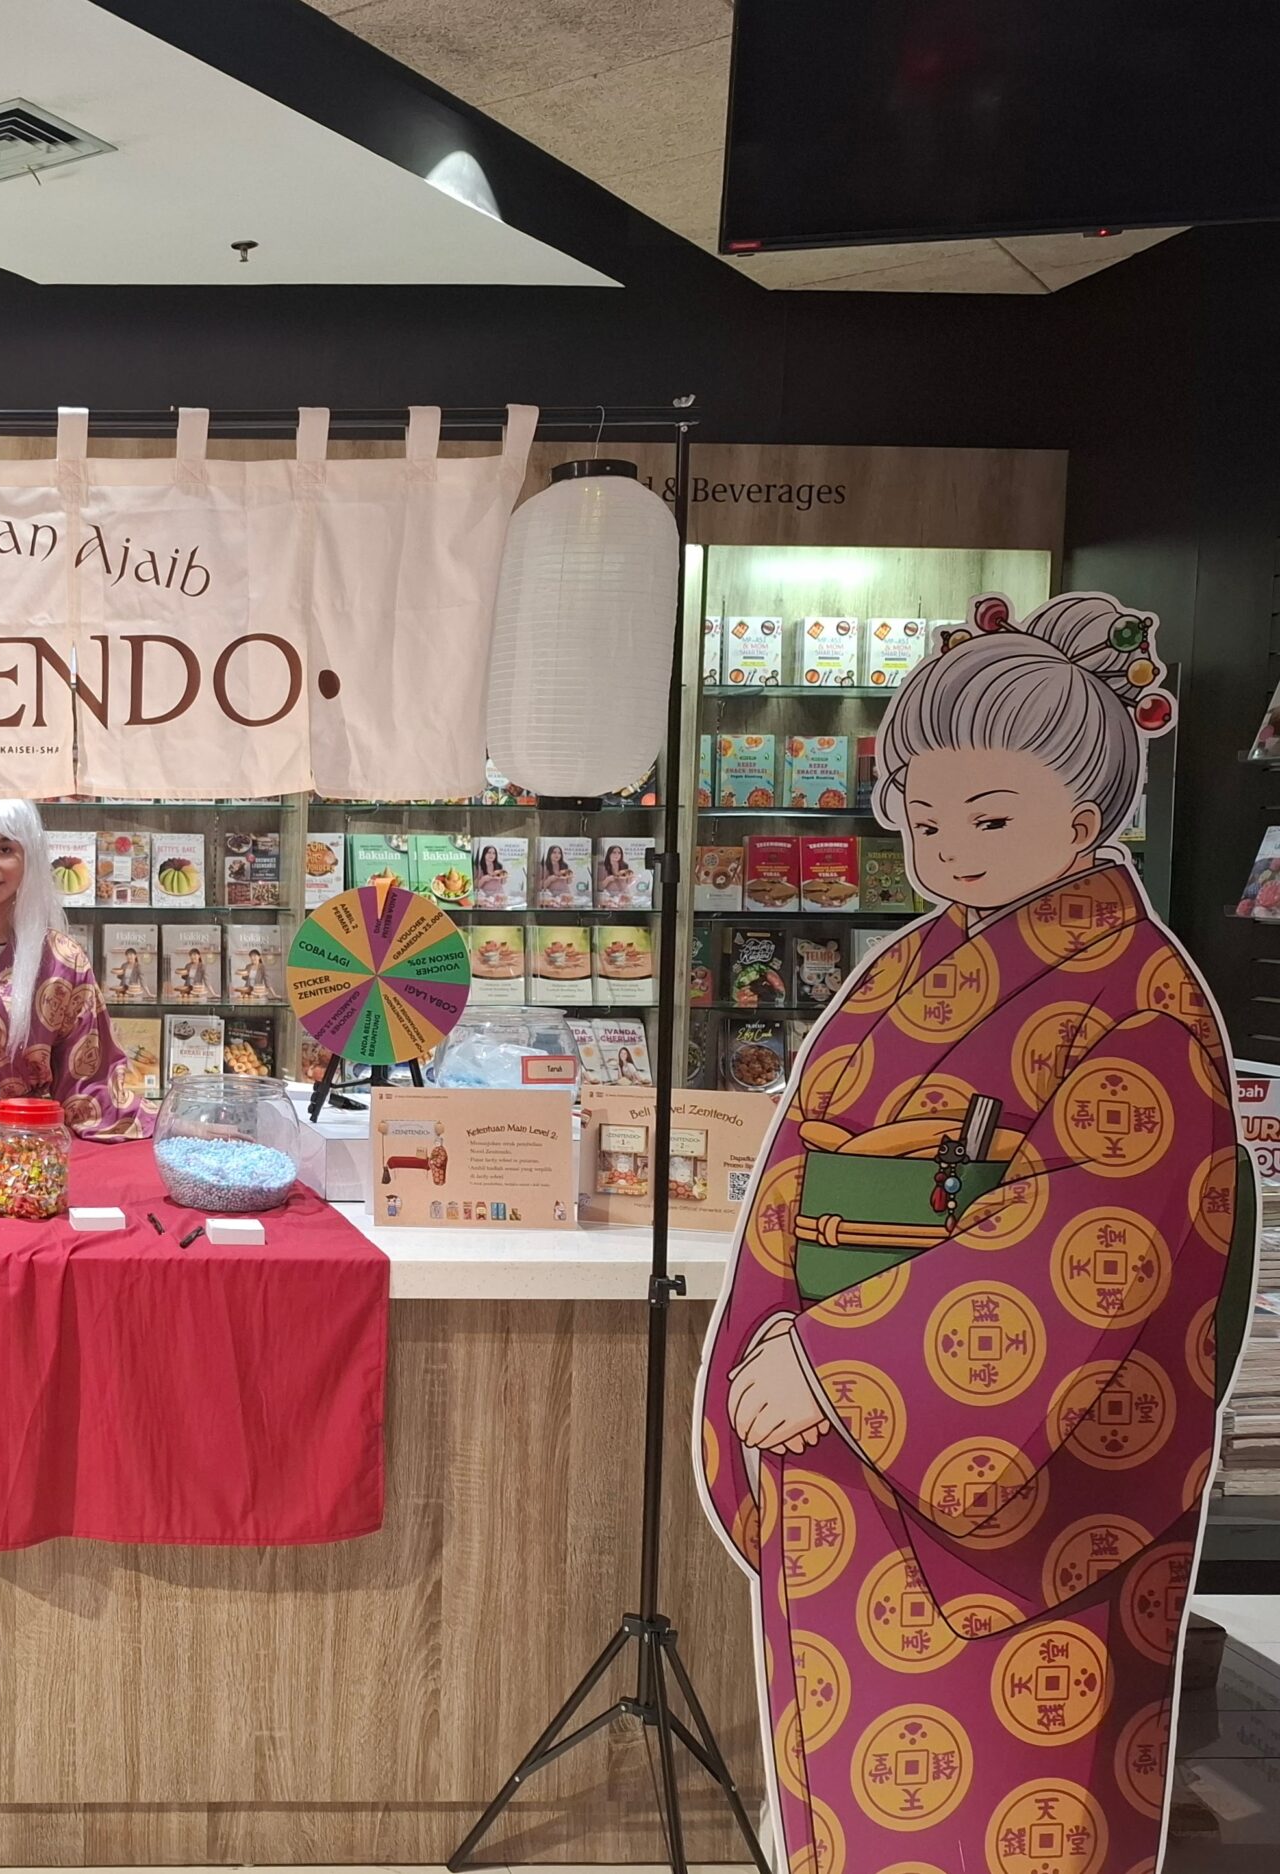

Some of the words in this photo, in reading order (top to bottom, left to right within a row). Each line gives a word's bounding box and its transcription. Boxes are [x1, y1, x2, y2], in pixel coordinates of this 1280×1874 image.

[692, 477, 846, 511] Beverages
[74, 523, 211, 597] Ajaib
[358, 851, 401, 860] Bakulan
[423, 851, 467, 860] Bakulan
[332, 906, 351, 934] PERMEN
[397, 916, 426, 944] VOUCHER
[299, 940, 326, 957] COBA
[327, 951, 351, 968] LAGI
[393, 931, 423, 961] GRAMEDIA
[407, 957, 428, 967] 20%
[429, 951, 465, 964] DISKON
[416, 963, 461, 976] VOUCHER
[292, 975, 331, 990] STICKER
[298, 982, 351, 1000] ZENITENDO
[404, 984, 427, 1000] LAGI
[430, 997, 458, 1014] COBA
[629, 1106, 651, 1120] Beli
[688, 1105, 744, 1127] Zenitendo
[466, 1125, 505, 1137] Ketentuan
[507, 1123, 527, 1133] Main
[529, 1126, 550, 1137] Level
